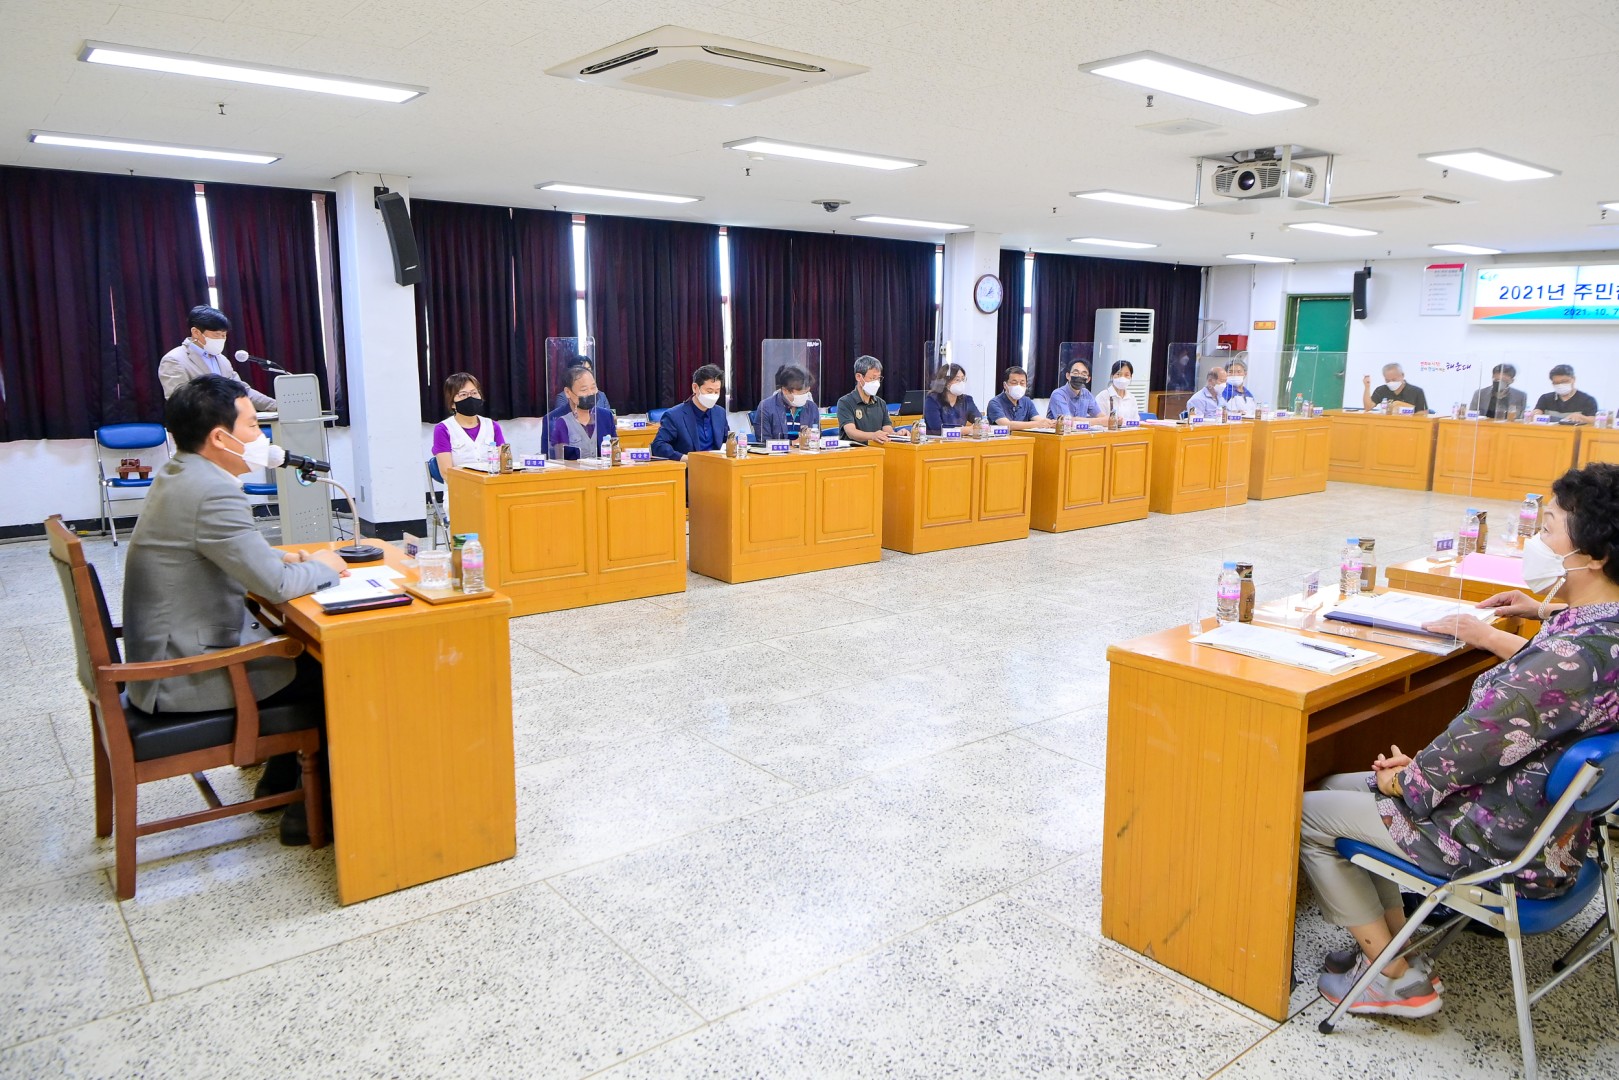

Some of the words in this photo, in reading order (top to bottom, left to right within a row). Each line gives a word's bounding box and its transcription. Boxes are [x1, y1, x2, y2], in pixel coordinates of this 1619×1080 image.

[1499, 283, 1566, 301] 2021년
[1573, 282, 1619, 301] 주민
[1446, 361, 1472, 372] 해운대
